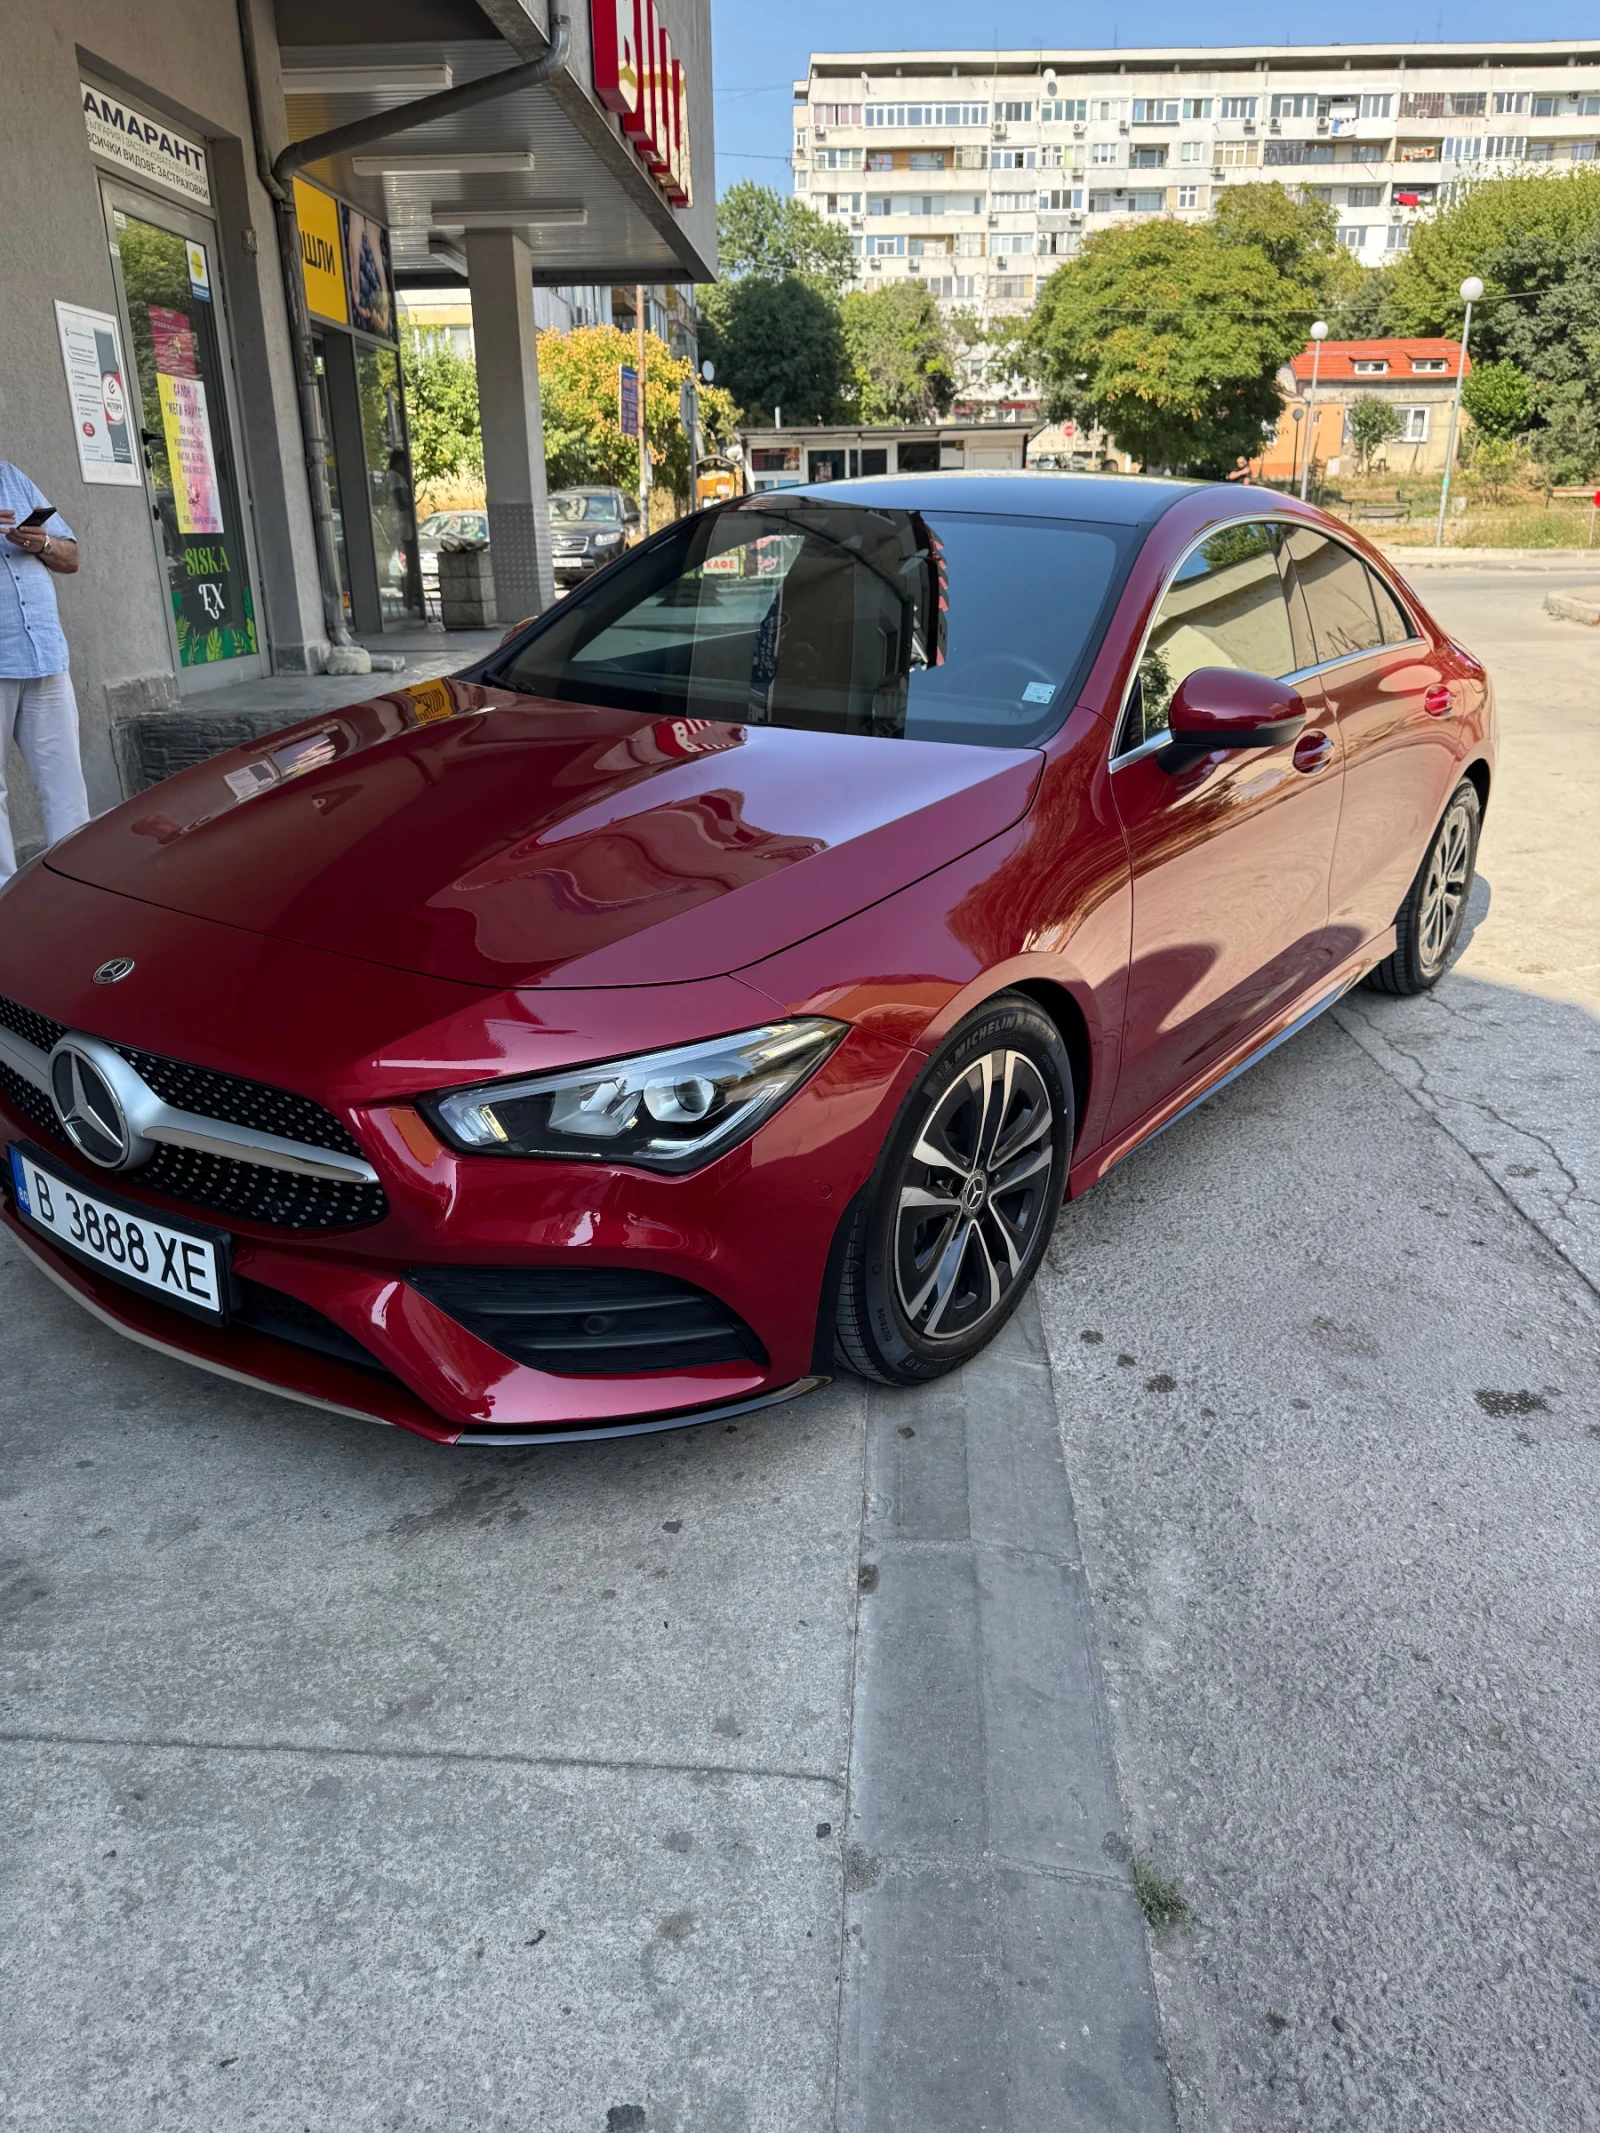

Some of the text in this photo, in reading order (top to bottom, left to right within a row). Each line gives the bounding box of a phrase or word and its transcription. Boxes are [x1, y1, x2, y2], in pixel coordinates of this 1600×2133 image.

[84, 91, 203, 171] АМАРАНТ
[123, 149, 156, 174] ВИДОВЕ
[158, 166, 208, 199] ЗАСТРАХОВКИ
[184, 167, 207, 184] БРОКЕР
[185, 546, 231, 576] SISKA
[706, 560, 735, 569] КАФЕ
[954, 1016, 1015, 1061] MICHELIN
[18, 1188, 30, 1205] BG
[33, 1170, 212, 1300] B 3888 XE
[877, 1307, 893, 1342] OUTSIDE
